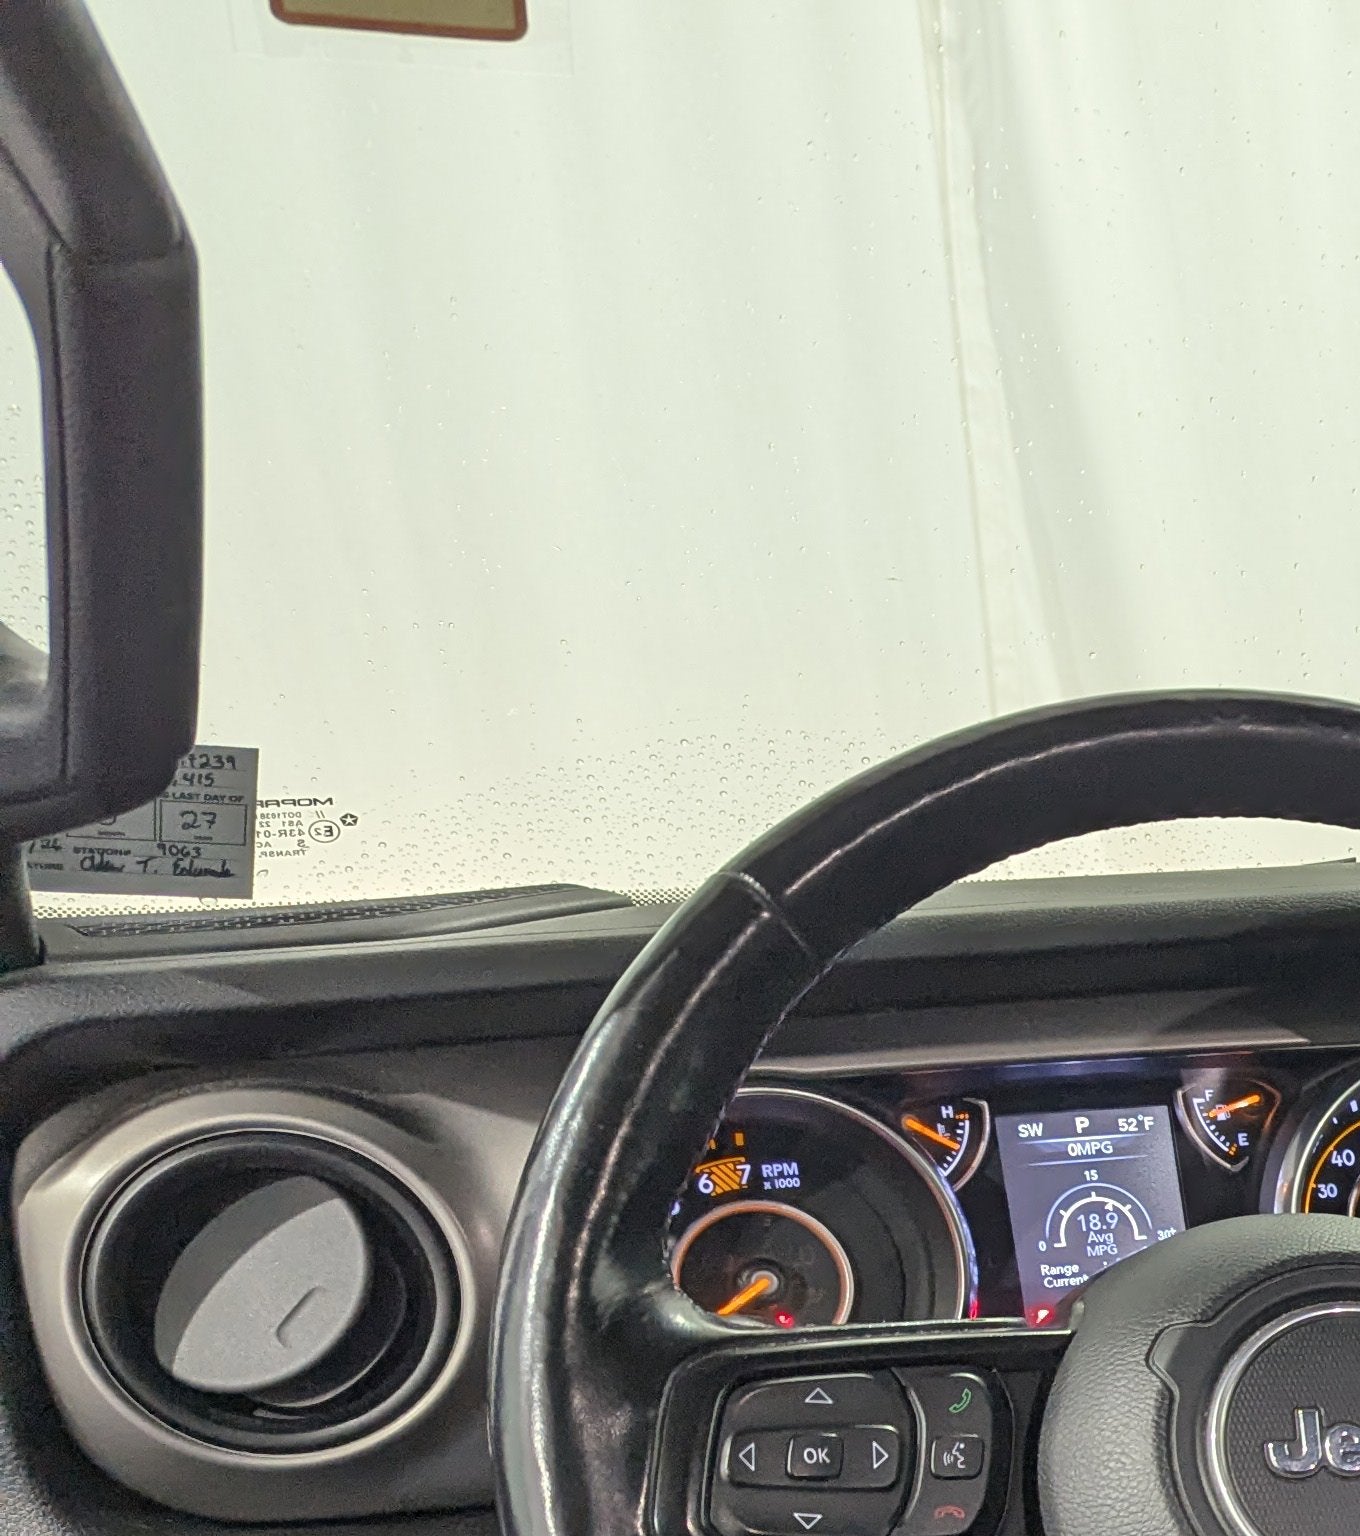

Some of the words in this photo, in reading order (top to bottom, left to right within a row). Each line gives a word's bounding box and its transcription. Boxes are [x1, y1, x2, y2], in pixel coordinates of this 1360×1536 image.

[180, 810, 216, 830] 27
[941, 1105, 954, 1118] H
[1018, 1122, 1043, 1137] SW
[1075, 1116, 1090, 1133] P
[1238, 1133, 1249, 1146] E
[1331, 1151, 1355, 1167] 40
[736, 1164, 751, 1184] 7
[762, 1162, 799, 1178] RPM
[1084, 1169, 1098, 1181] 15
[698, 1173, 714, 1194] 6
[775, 1178, 800, 1189] 1000
[1318, 1183, 1338, 1199] 30
[1077, 1212, 1118, 1231] 18.9
[1038, 1241, 1047, 1251] 0
[1088, 1232, 1114, 1244] Avg
[1087, 1244, 1118, 1257] MPG
[1040, 1264, 1079, 1276] Range
[803, 1447, 831, 1464] OK
